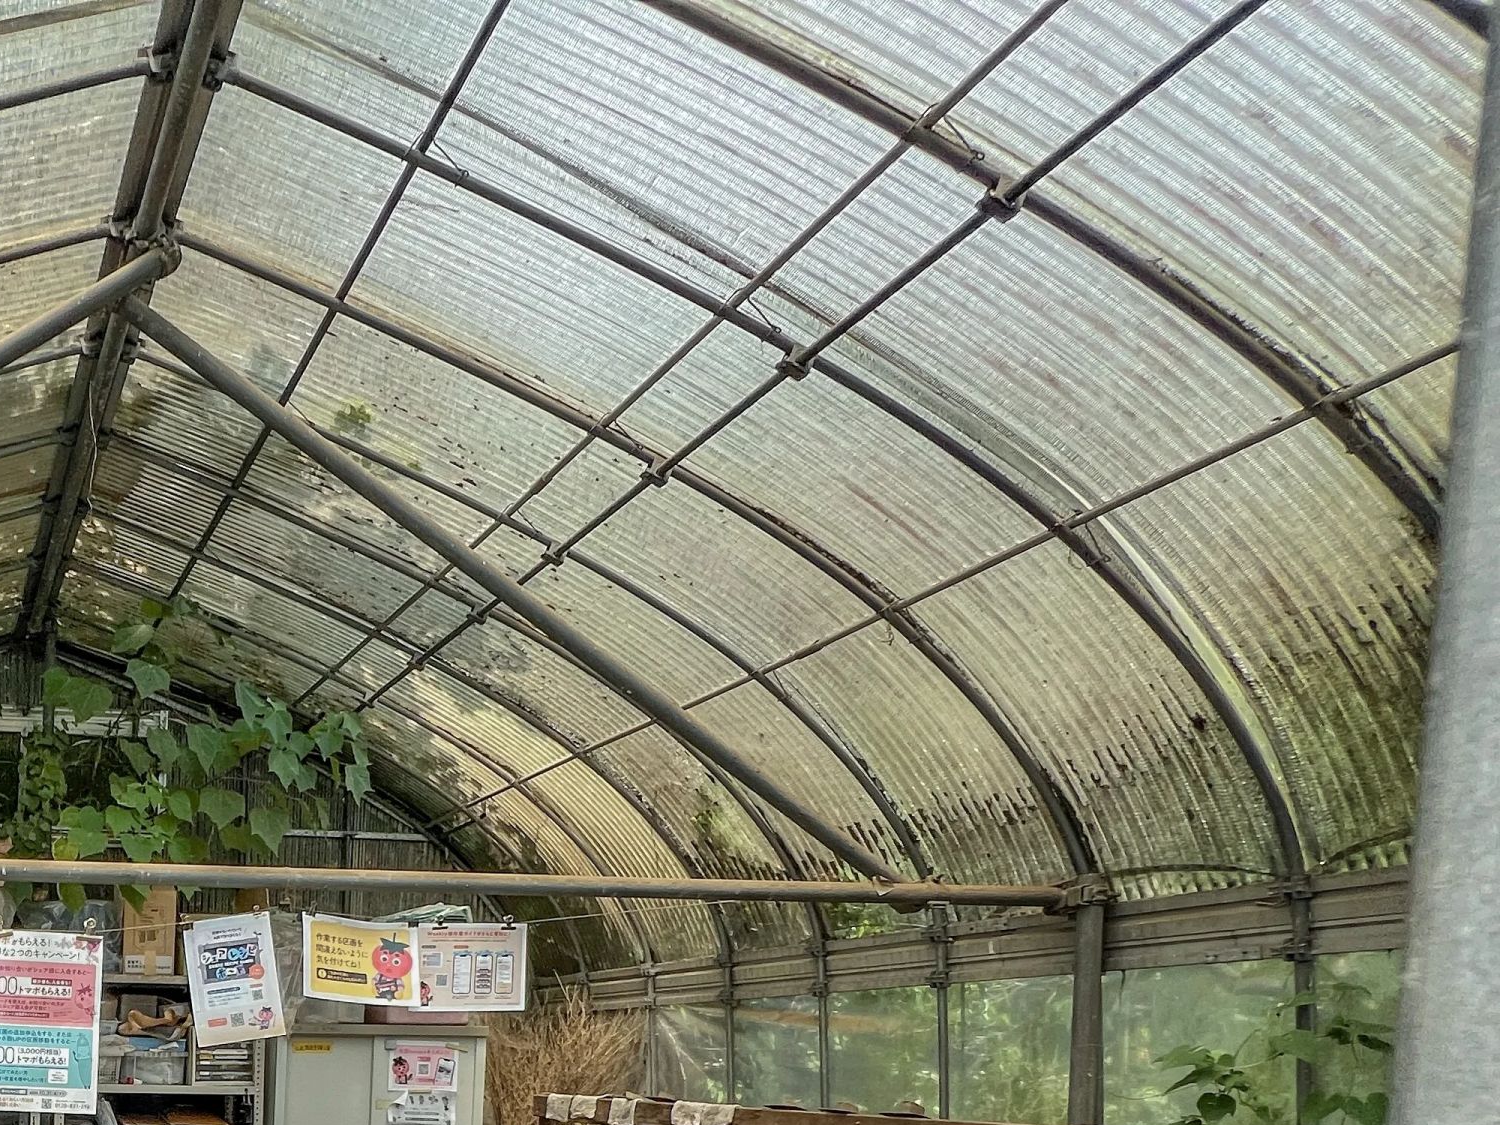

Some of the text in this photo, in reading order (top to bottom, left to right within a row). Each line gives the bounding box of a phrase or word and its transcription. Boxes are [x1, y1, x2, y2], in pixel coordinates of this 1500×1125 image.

[316, 933, 364, 947] 作業する区画を
[315, 944, 369, 958] 間違えないように
